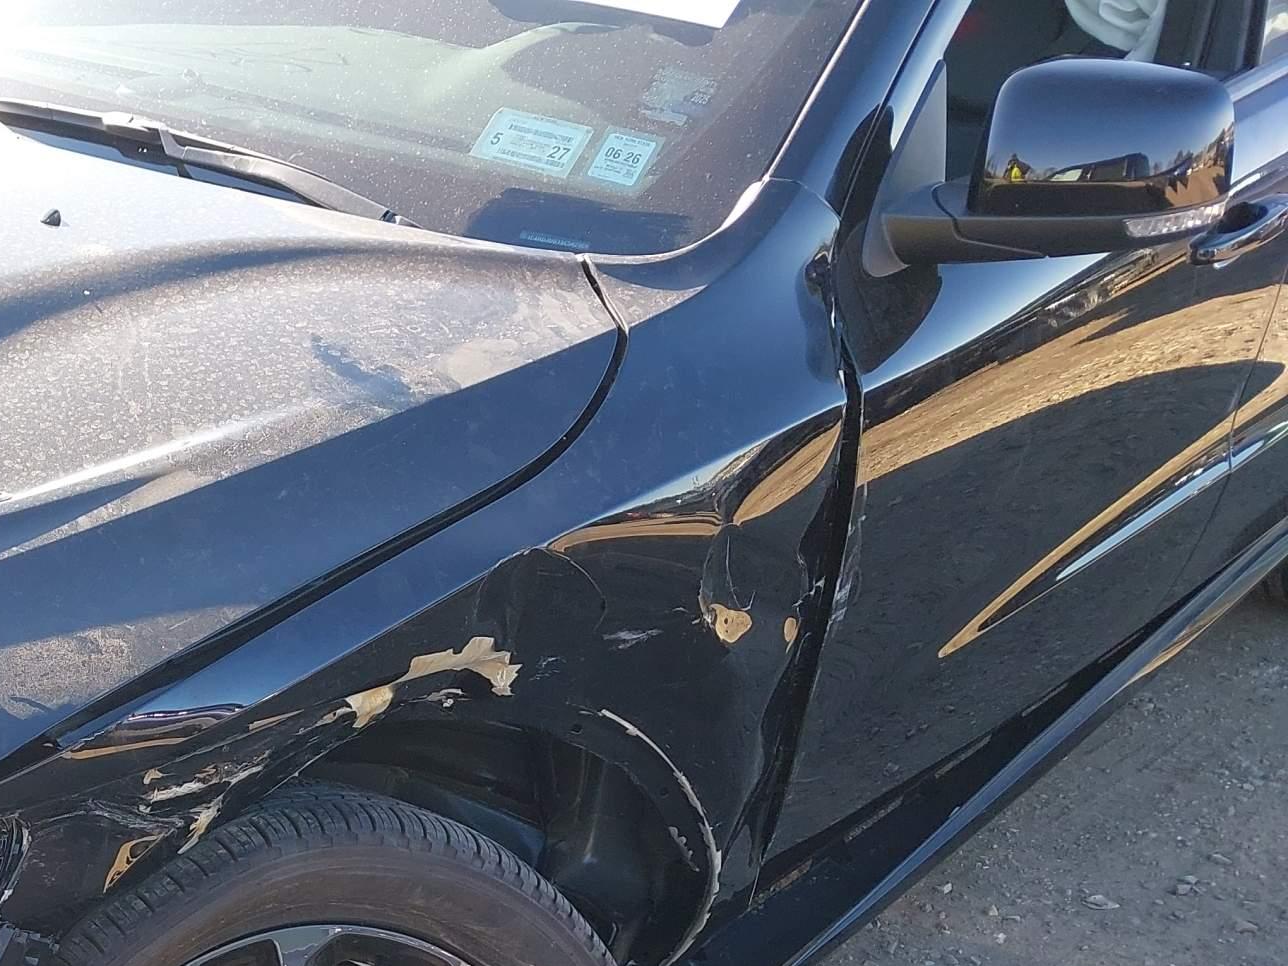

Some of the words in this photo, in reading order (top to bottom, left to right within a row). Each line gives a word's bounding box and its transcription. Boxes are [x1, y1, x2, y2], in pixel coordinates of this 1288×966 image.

[490, 132, 504, 145] 5
[546, 145, 571, 161] 27
[604, 146, 623, 160] 06
[623, 151, 642, 165] 26
